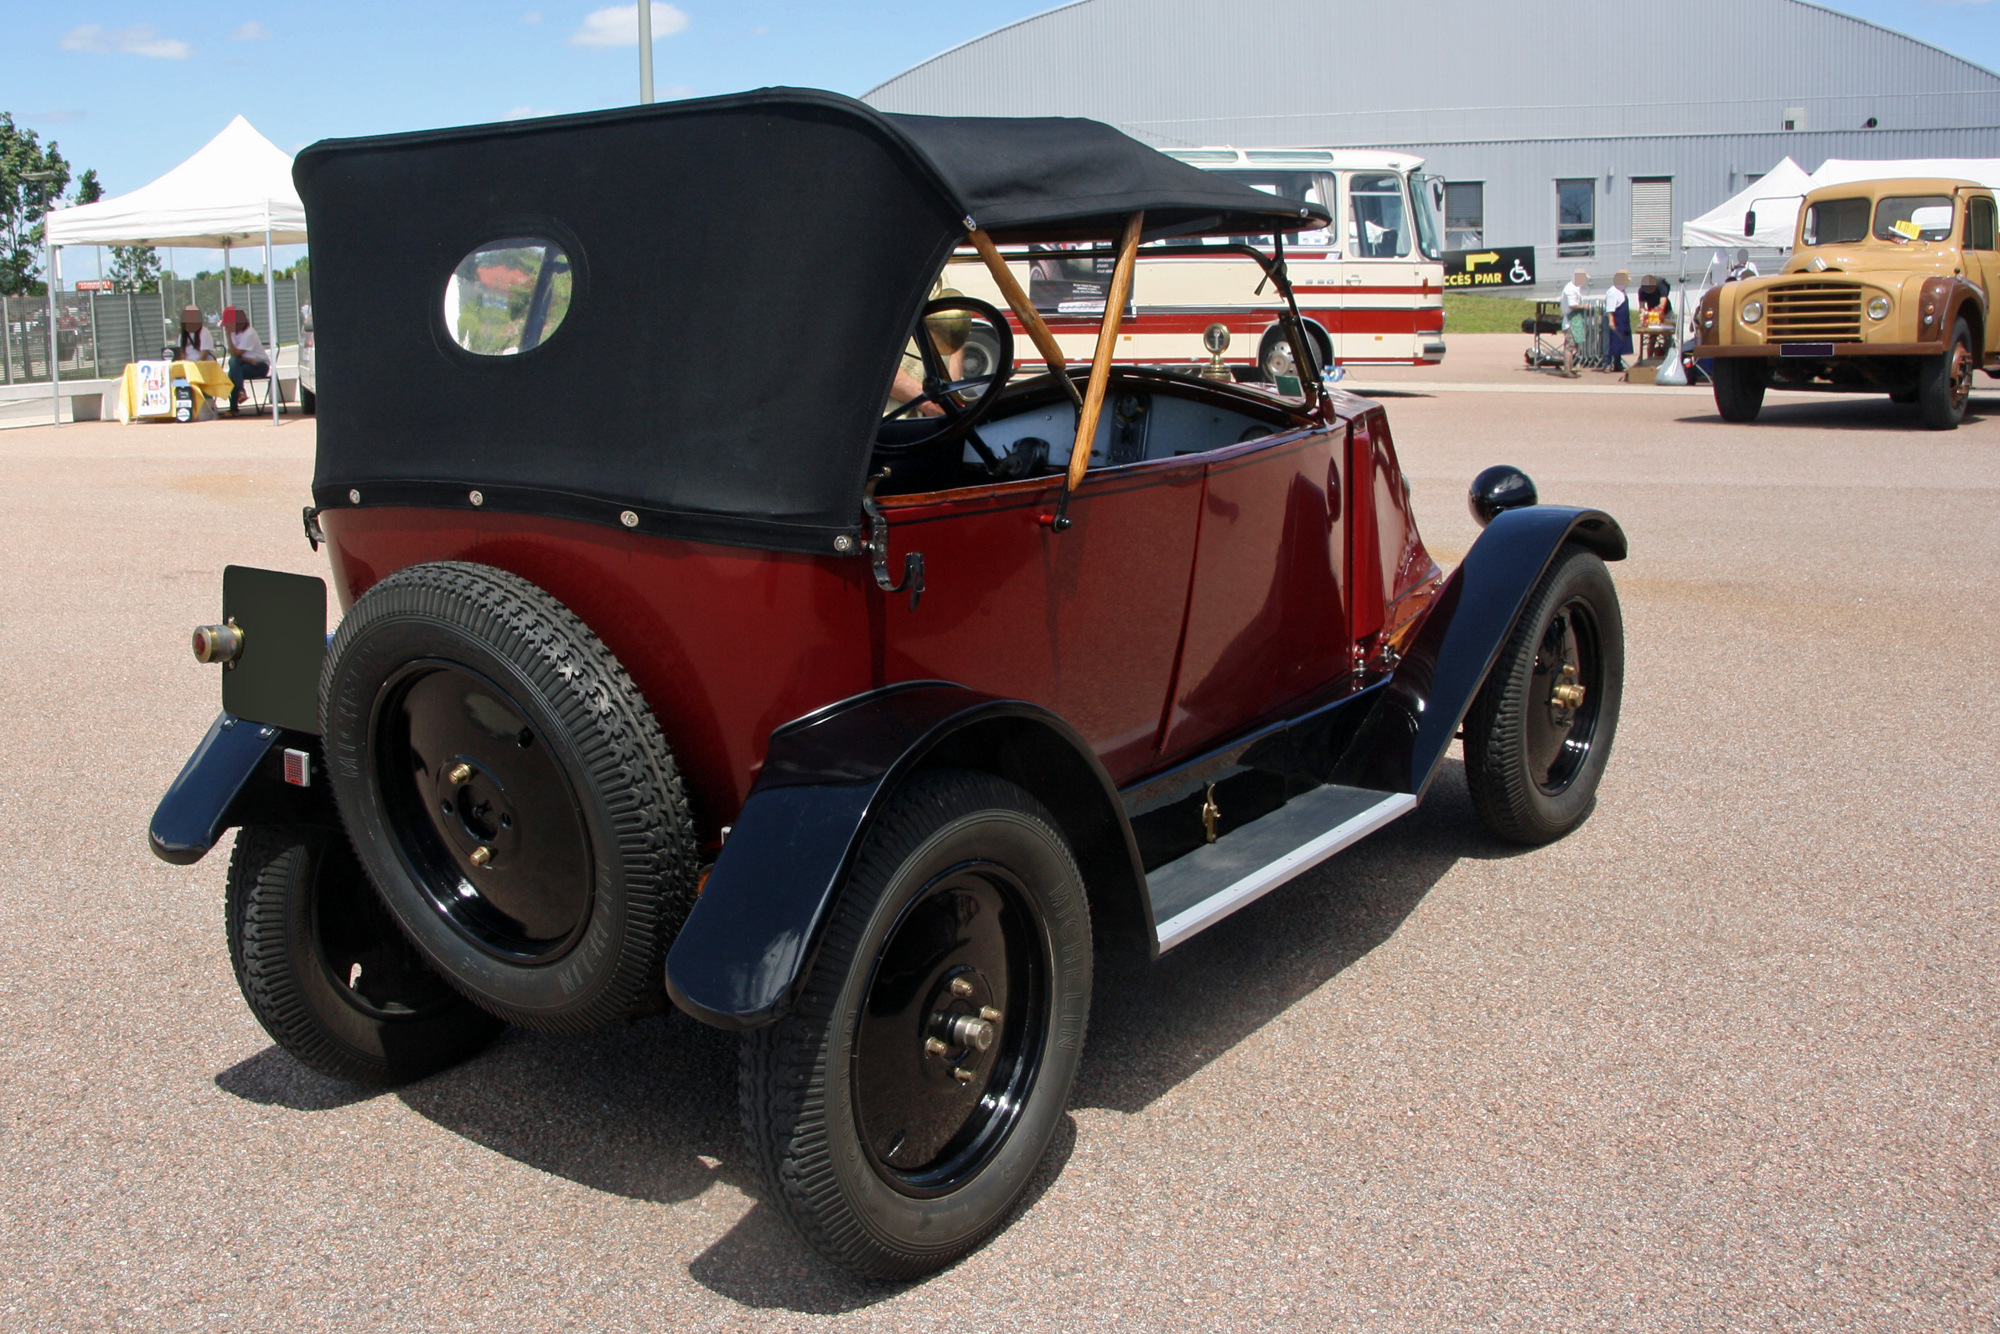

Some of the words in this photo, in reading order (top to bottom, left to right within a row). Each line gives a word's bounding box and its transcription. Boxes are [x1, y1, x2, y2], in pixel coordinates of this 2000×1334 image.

[1443, 272, 1472, 286] CCÈS
[1474, 272, 1502, 284] PMR
[558, 858, 613, 996] MICHELIN
[1048, 881, 1084, 1051] MICHELIN
